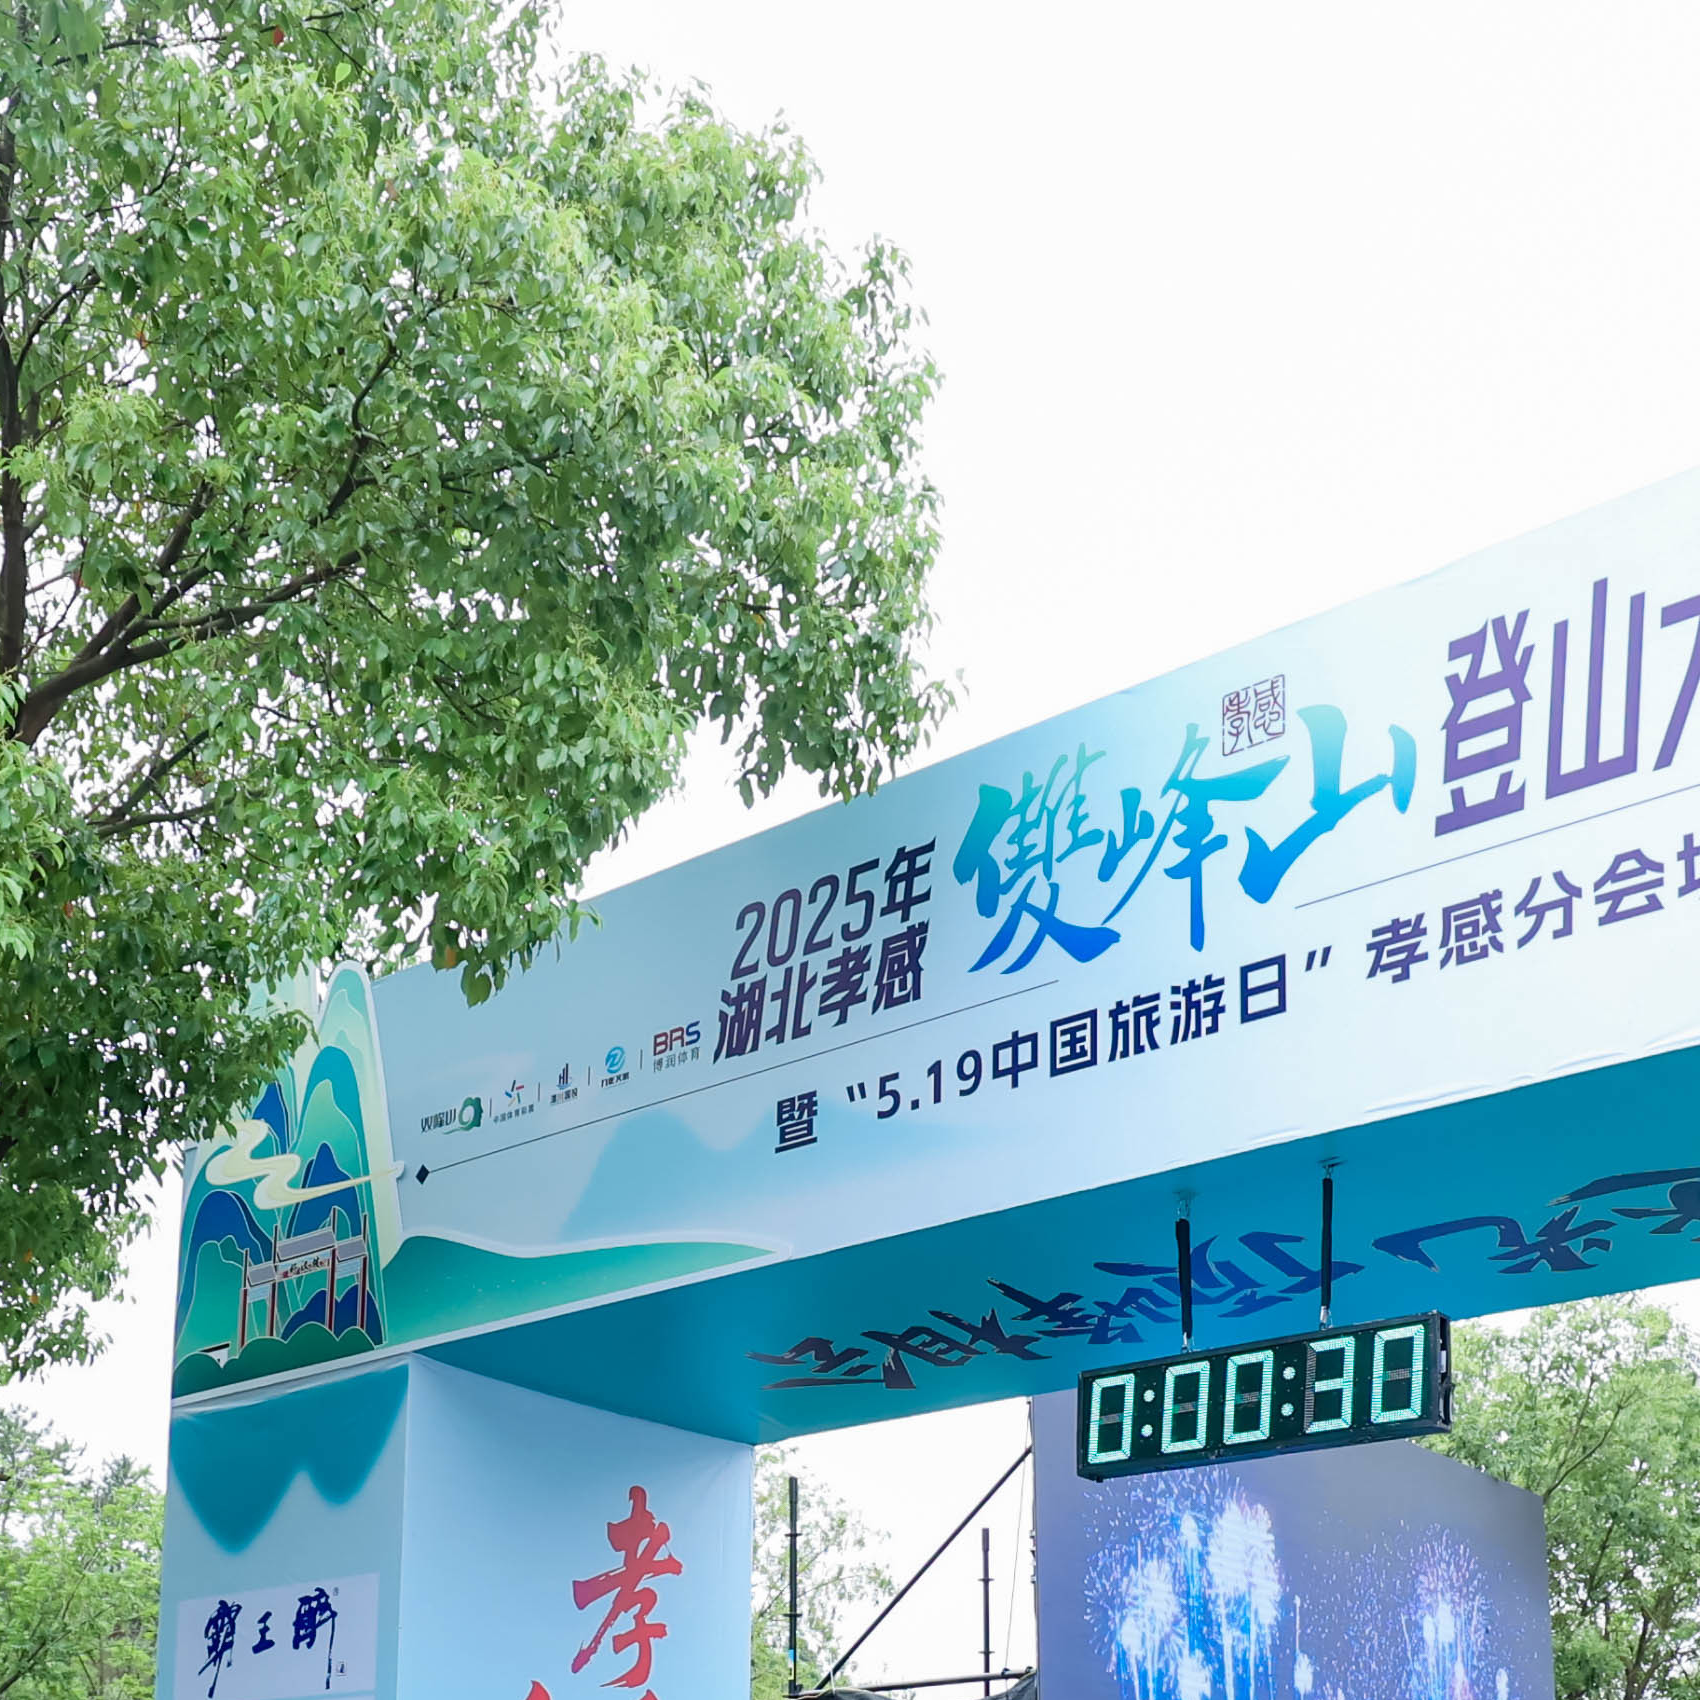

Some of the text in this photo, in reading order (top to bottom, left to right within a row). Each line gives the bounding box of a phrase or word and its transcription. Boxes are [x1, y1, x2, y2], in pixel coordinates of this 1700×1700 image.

[730, 836, 937, 982] 2025年
[652, 1045, 701, 1073] 博润体育
[653, 1020, 700, 1058] BRS
[712, 918, 930, 1065] 湖北孝感
[1086, 1323, 1427, 1465] 0:00:30
